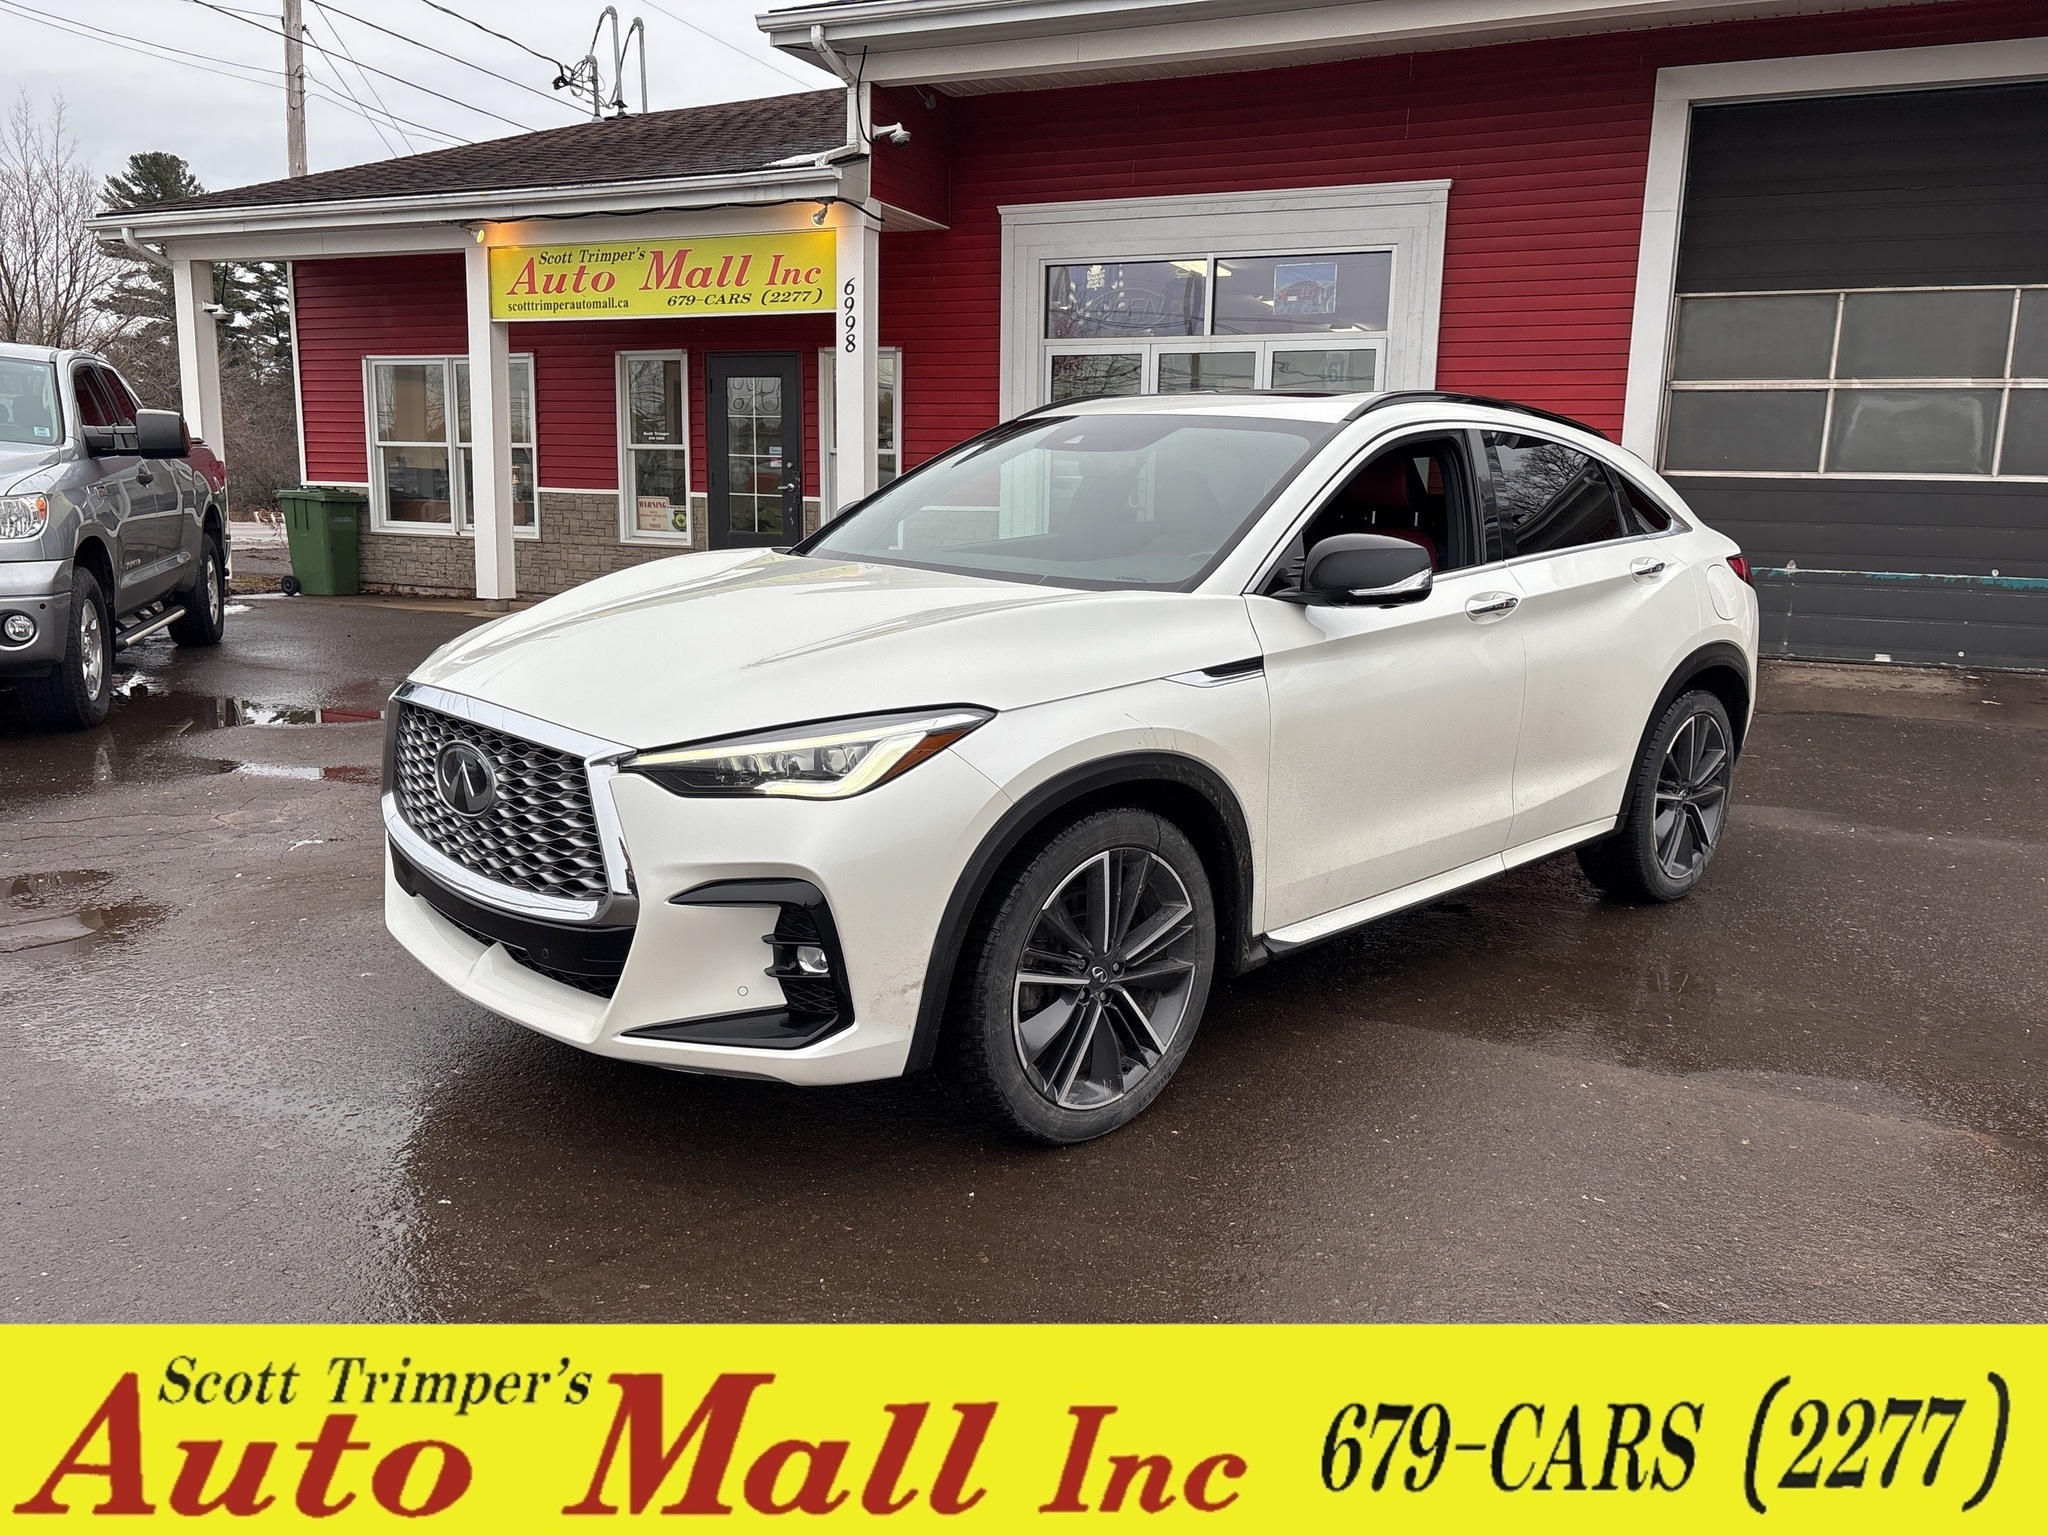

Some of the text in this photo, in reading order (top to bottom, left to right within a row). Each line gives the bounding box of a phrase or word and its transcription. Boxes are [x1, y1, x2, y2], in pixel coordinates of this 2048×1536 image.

[538, 247, 646, 267] Scott Trimper's
[506, 249, 823, 296] Auto Mall Inc
[507, 297, 630, 314] scotttrimperautomall.ca
[667, 291, 752, 308] 679-CARS
[639, 501, 667, 509] WARNING
